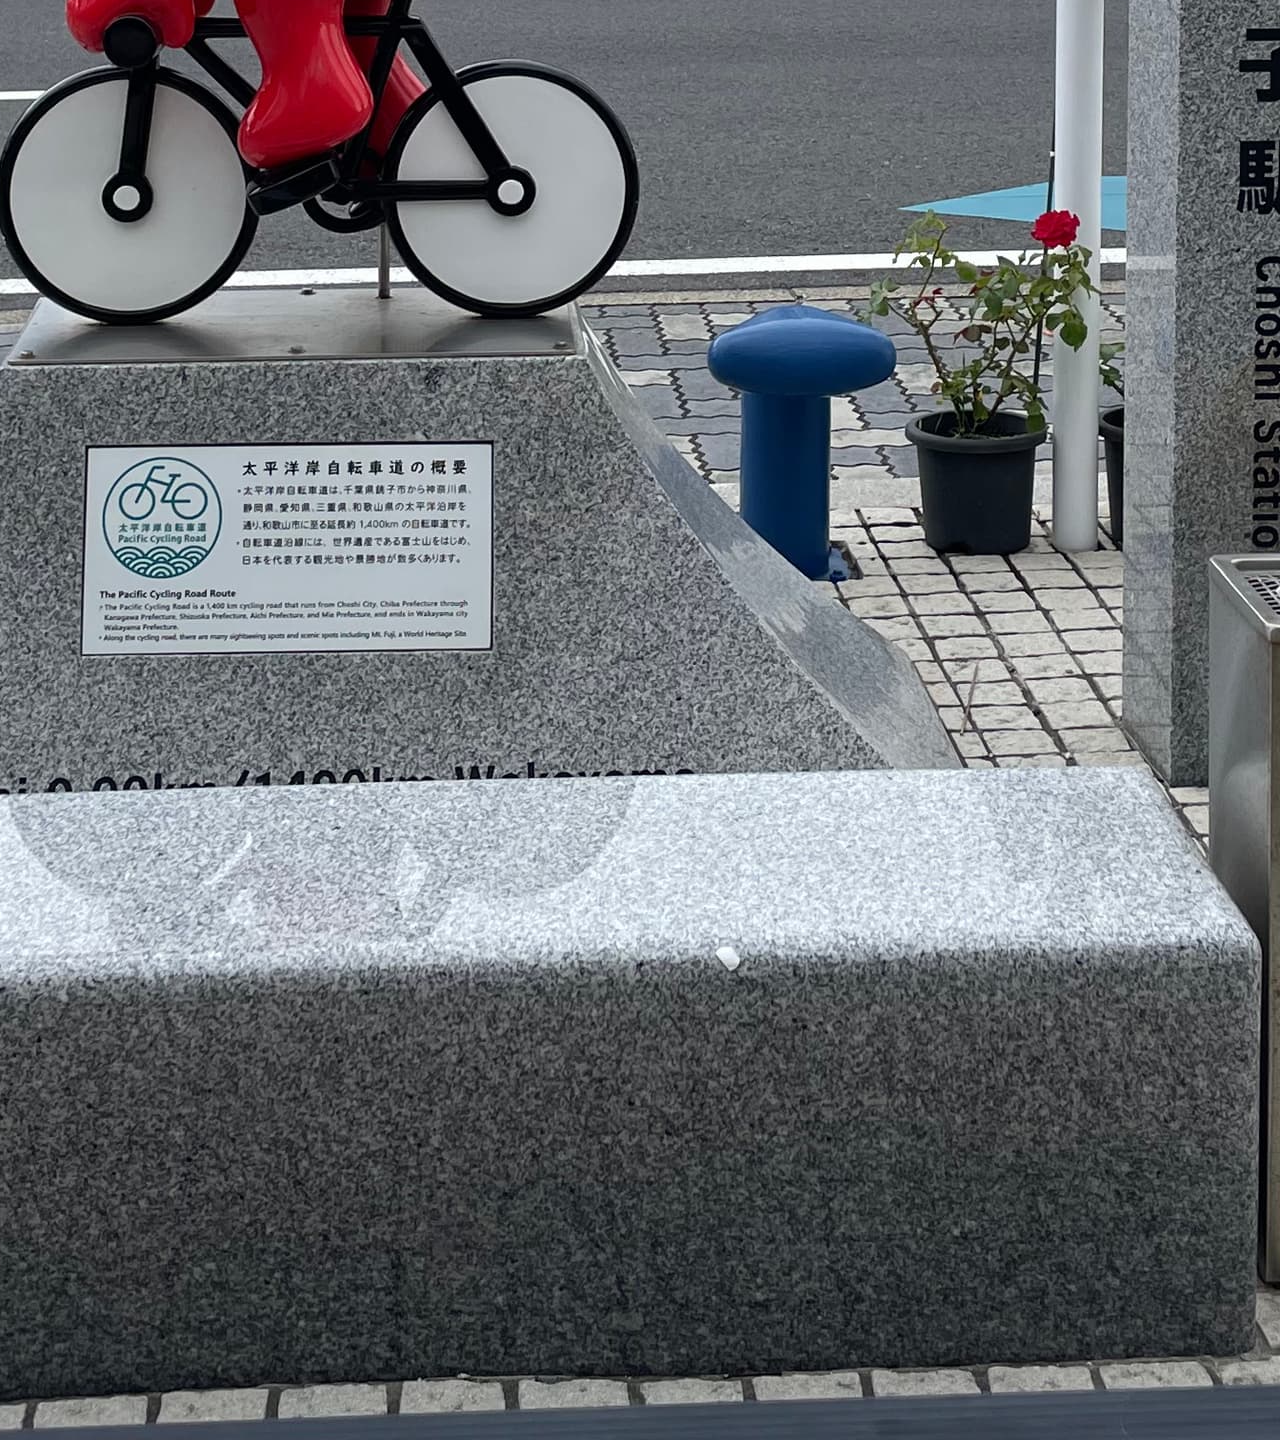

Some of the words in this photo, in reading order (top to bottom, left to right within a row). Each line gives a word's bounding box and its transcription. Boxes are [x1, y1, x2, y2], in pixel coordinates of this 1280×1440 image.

[242, 458, 468, 477] 太平洋岸自転車道の概要
[118, 522, 207, 533] 太平洋岸自転車道
[118, 535, 148, 544] Pacific
[150, 534, 182, 545] Cycling
[184, 534, 207, 543] Road
[100, 590, 116, 599] The
[118, 589, 148, 599] Pacific
[149, 589, 183, 600] Cycling
[184, 589, 208, 598] Road
[210, 588, 237, 598] Route
[119, 603, 143, 611] Pacific
[144, 603, 171, 612] Cycling
[172, 602, 191, 610] Road
[240, 602, 265, 611] cycling
[318, 601, 335, 609] from
[402, 600, 438, 608] Prefecture
[440, 600, 469, 609] through
[137, 634, 160, 642] cycling
